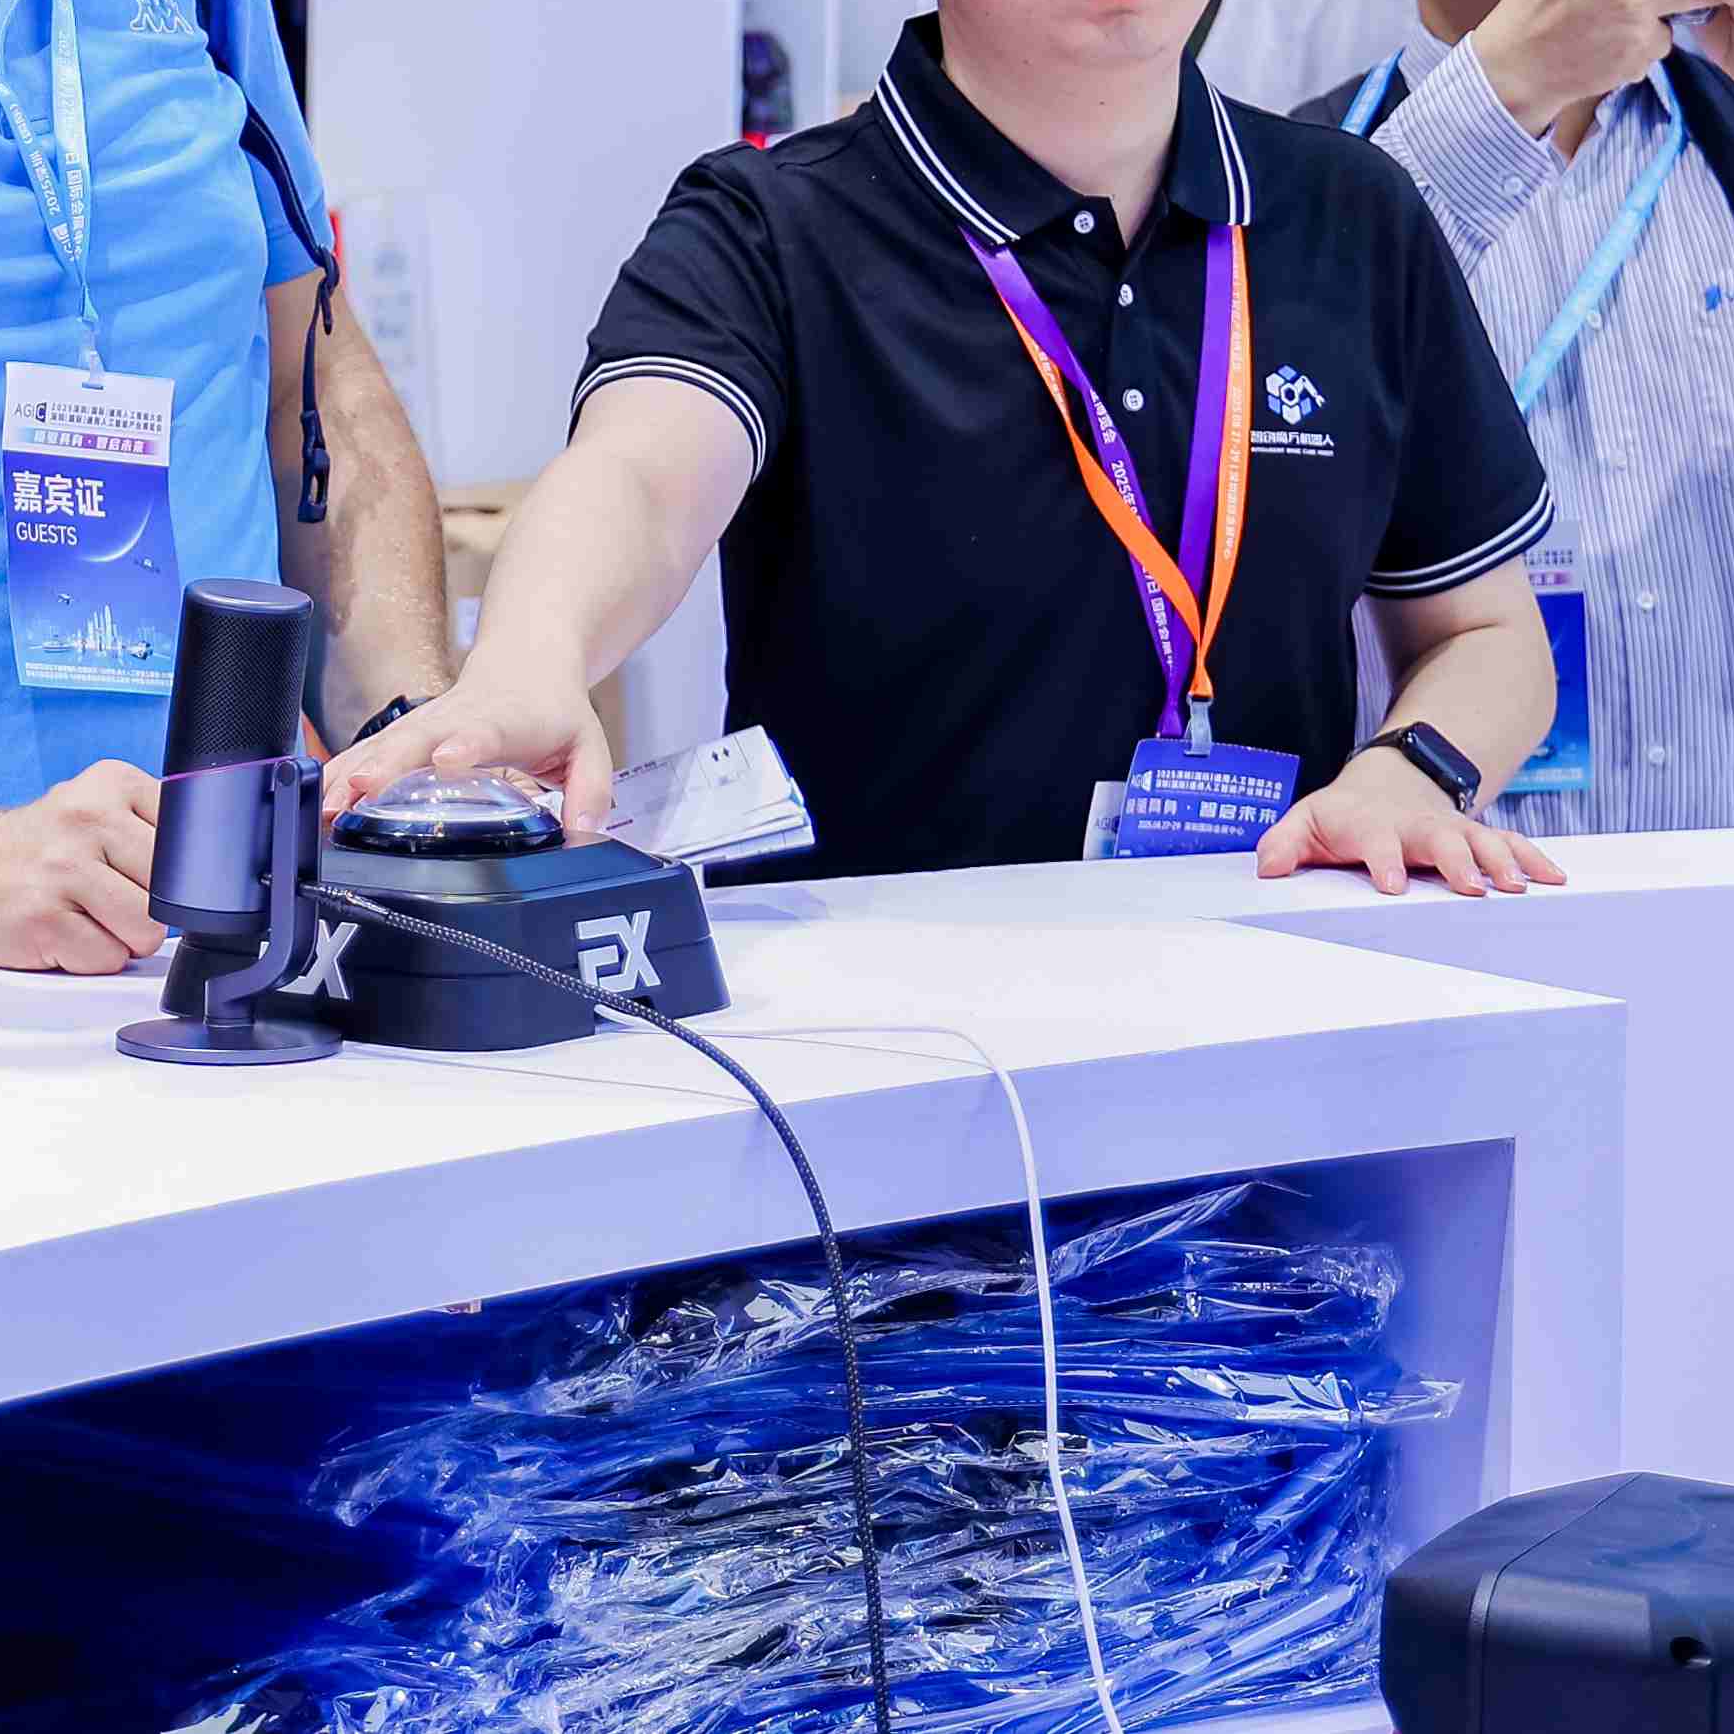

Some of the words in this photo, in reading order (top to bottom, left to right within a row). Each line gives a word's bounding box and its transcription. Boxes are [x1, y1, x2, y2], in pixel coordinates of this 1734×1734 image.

[14, 402, 47, 423] AGIC
[11, 470, 106, 518] 嘉宾证
[16, 522, 78, 546] GUESTS
[1151, 597, 1175, 668] 国际会展中
[574, 910, 663, 993] EX
